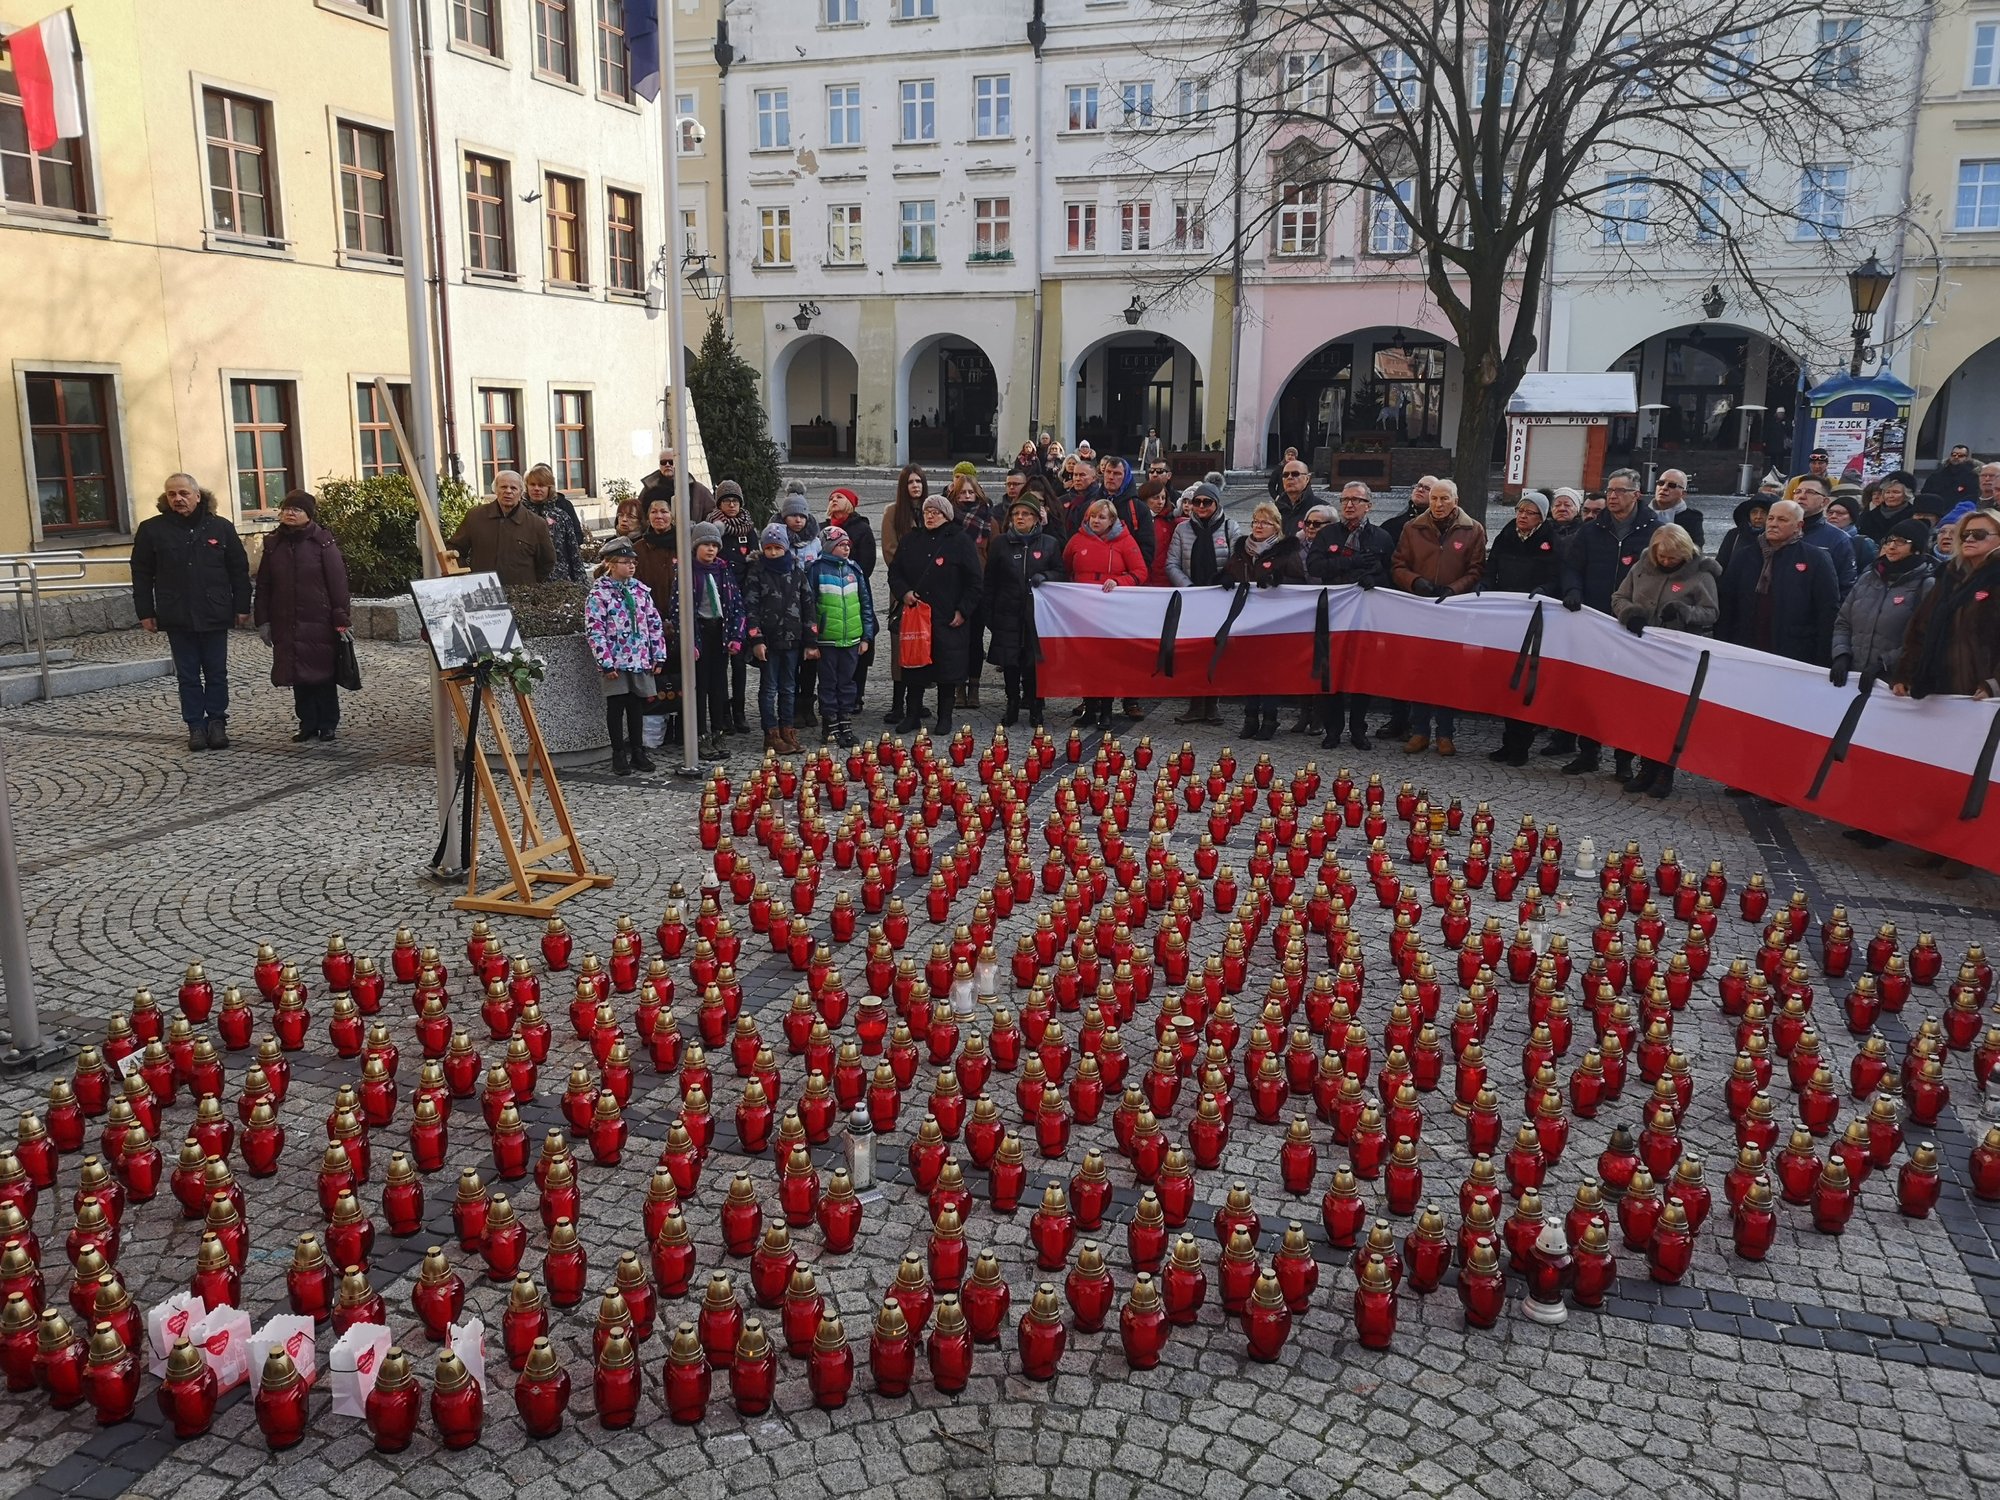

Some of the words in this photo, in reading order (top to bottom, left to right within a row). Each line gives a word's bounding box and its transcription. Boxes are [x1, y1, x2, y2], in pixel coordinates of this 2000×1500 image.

[1519, 417, 1552, 425] KAWA
[1568, 417, 1599, 425] PIWO
[1838, 420, 1844, 429] Z
[1845, 420, 1863, 429] JCK
[1512, 428, 1523, 480] NAPOJE
